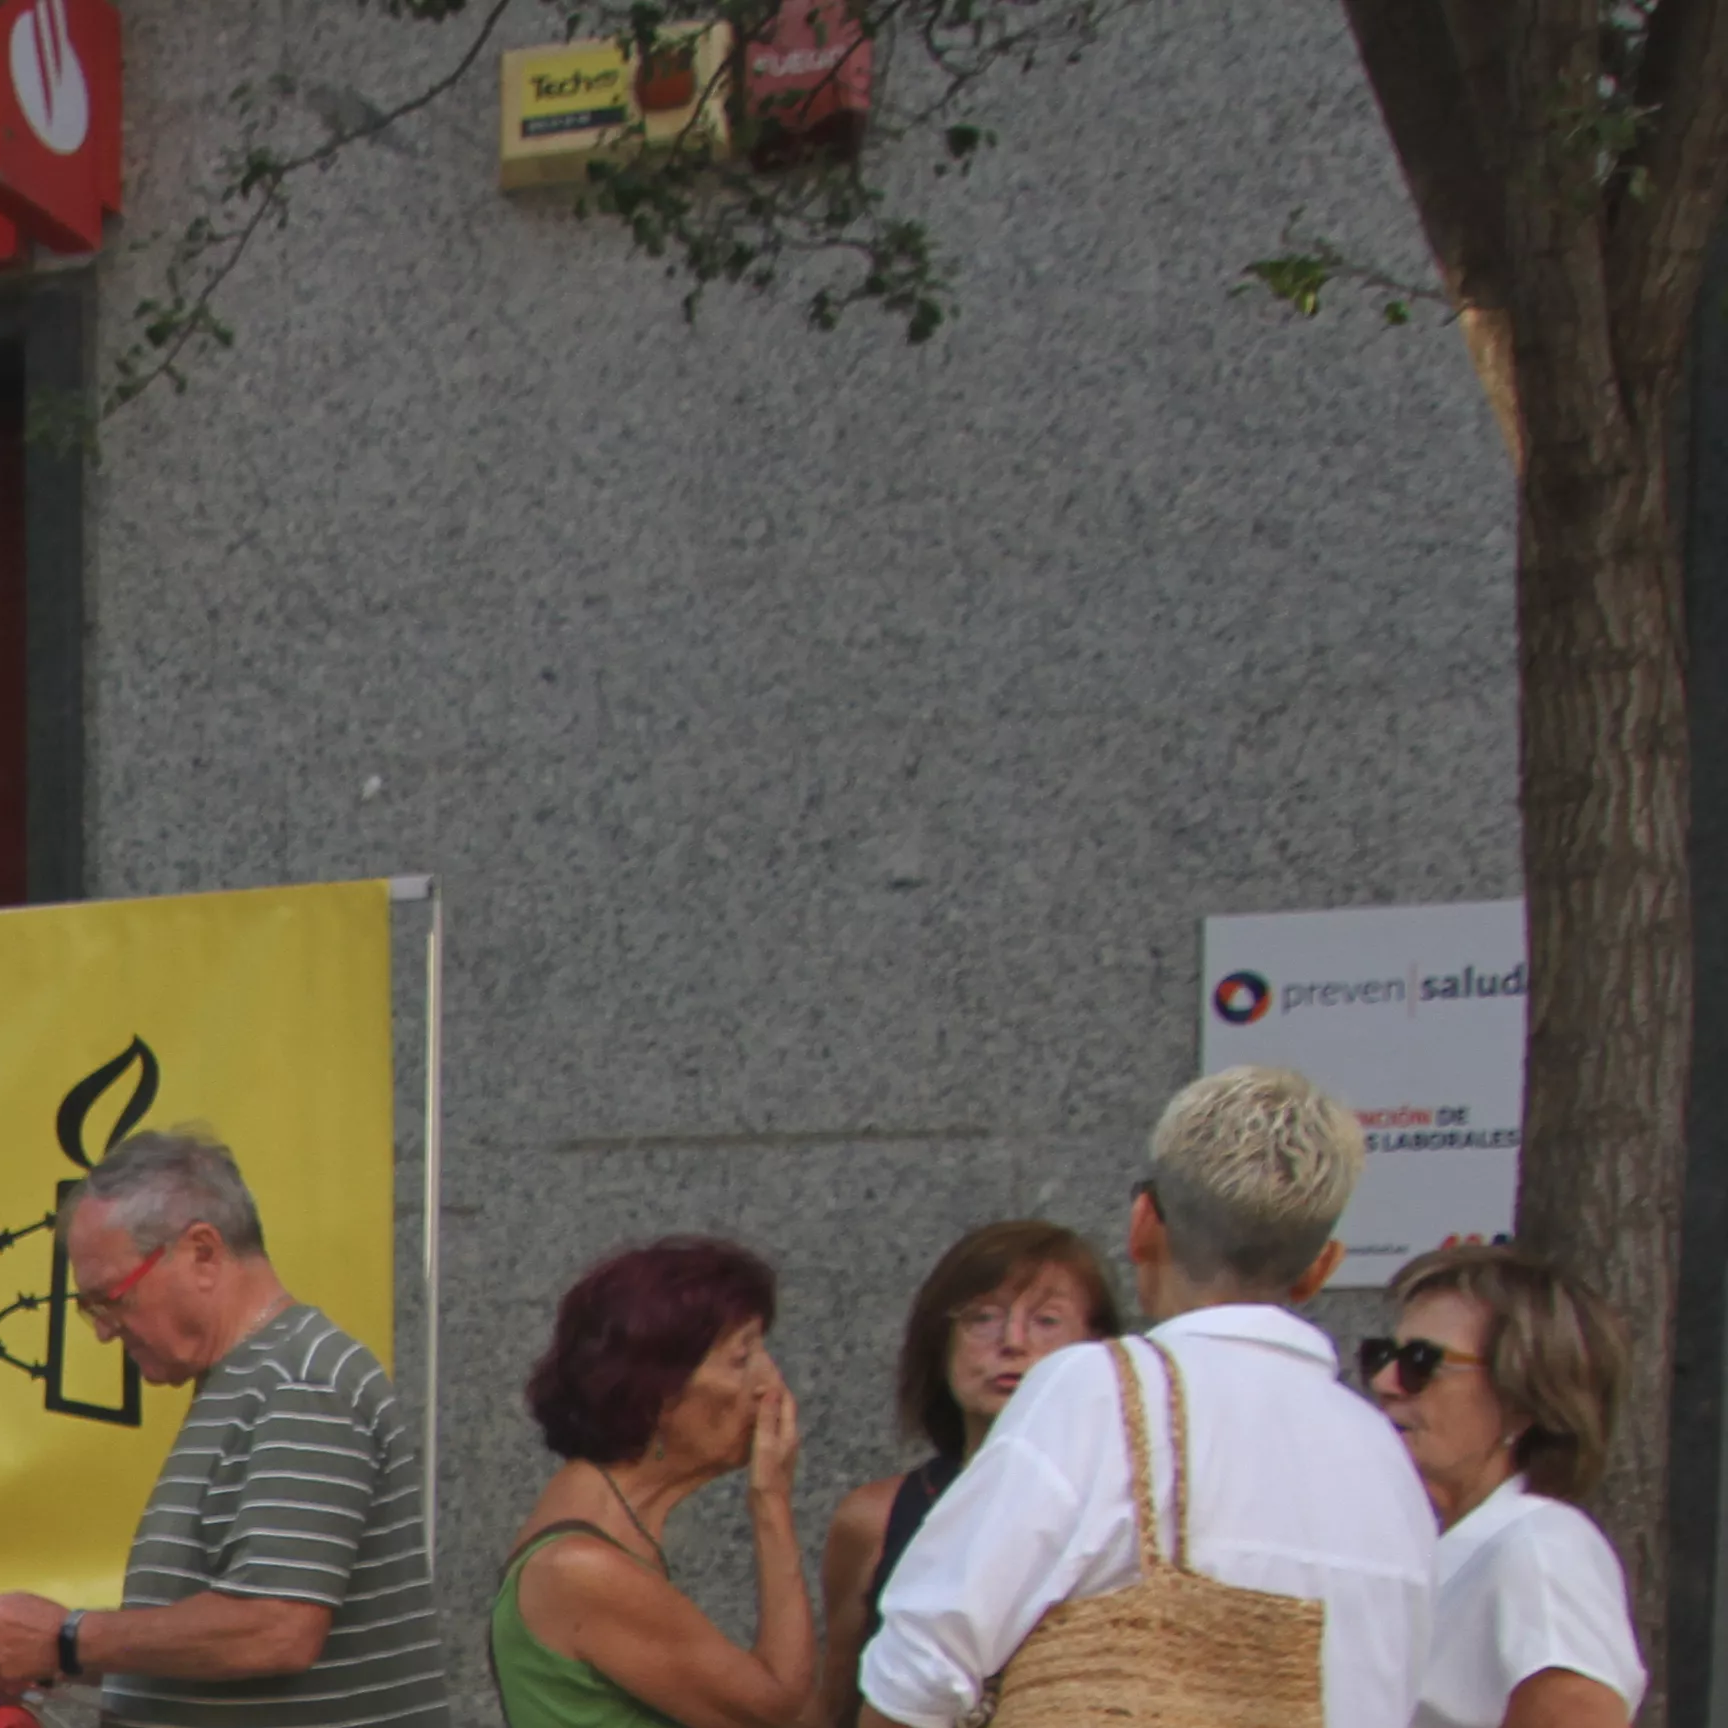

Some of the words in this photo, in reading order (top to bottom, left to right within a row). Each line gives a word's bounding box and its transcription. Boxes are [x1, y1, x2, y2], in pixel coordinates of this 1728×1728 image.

[1421, 961, 1528, 1001] salud
[1436, 1105, 1470, 1127] DE
[1382, 1129, 1520, 1152] LABORALES
